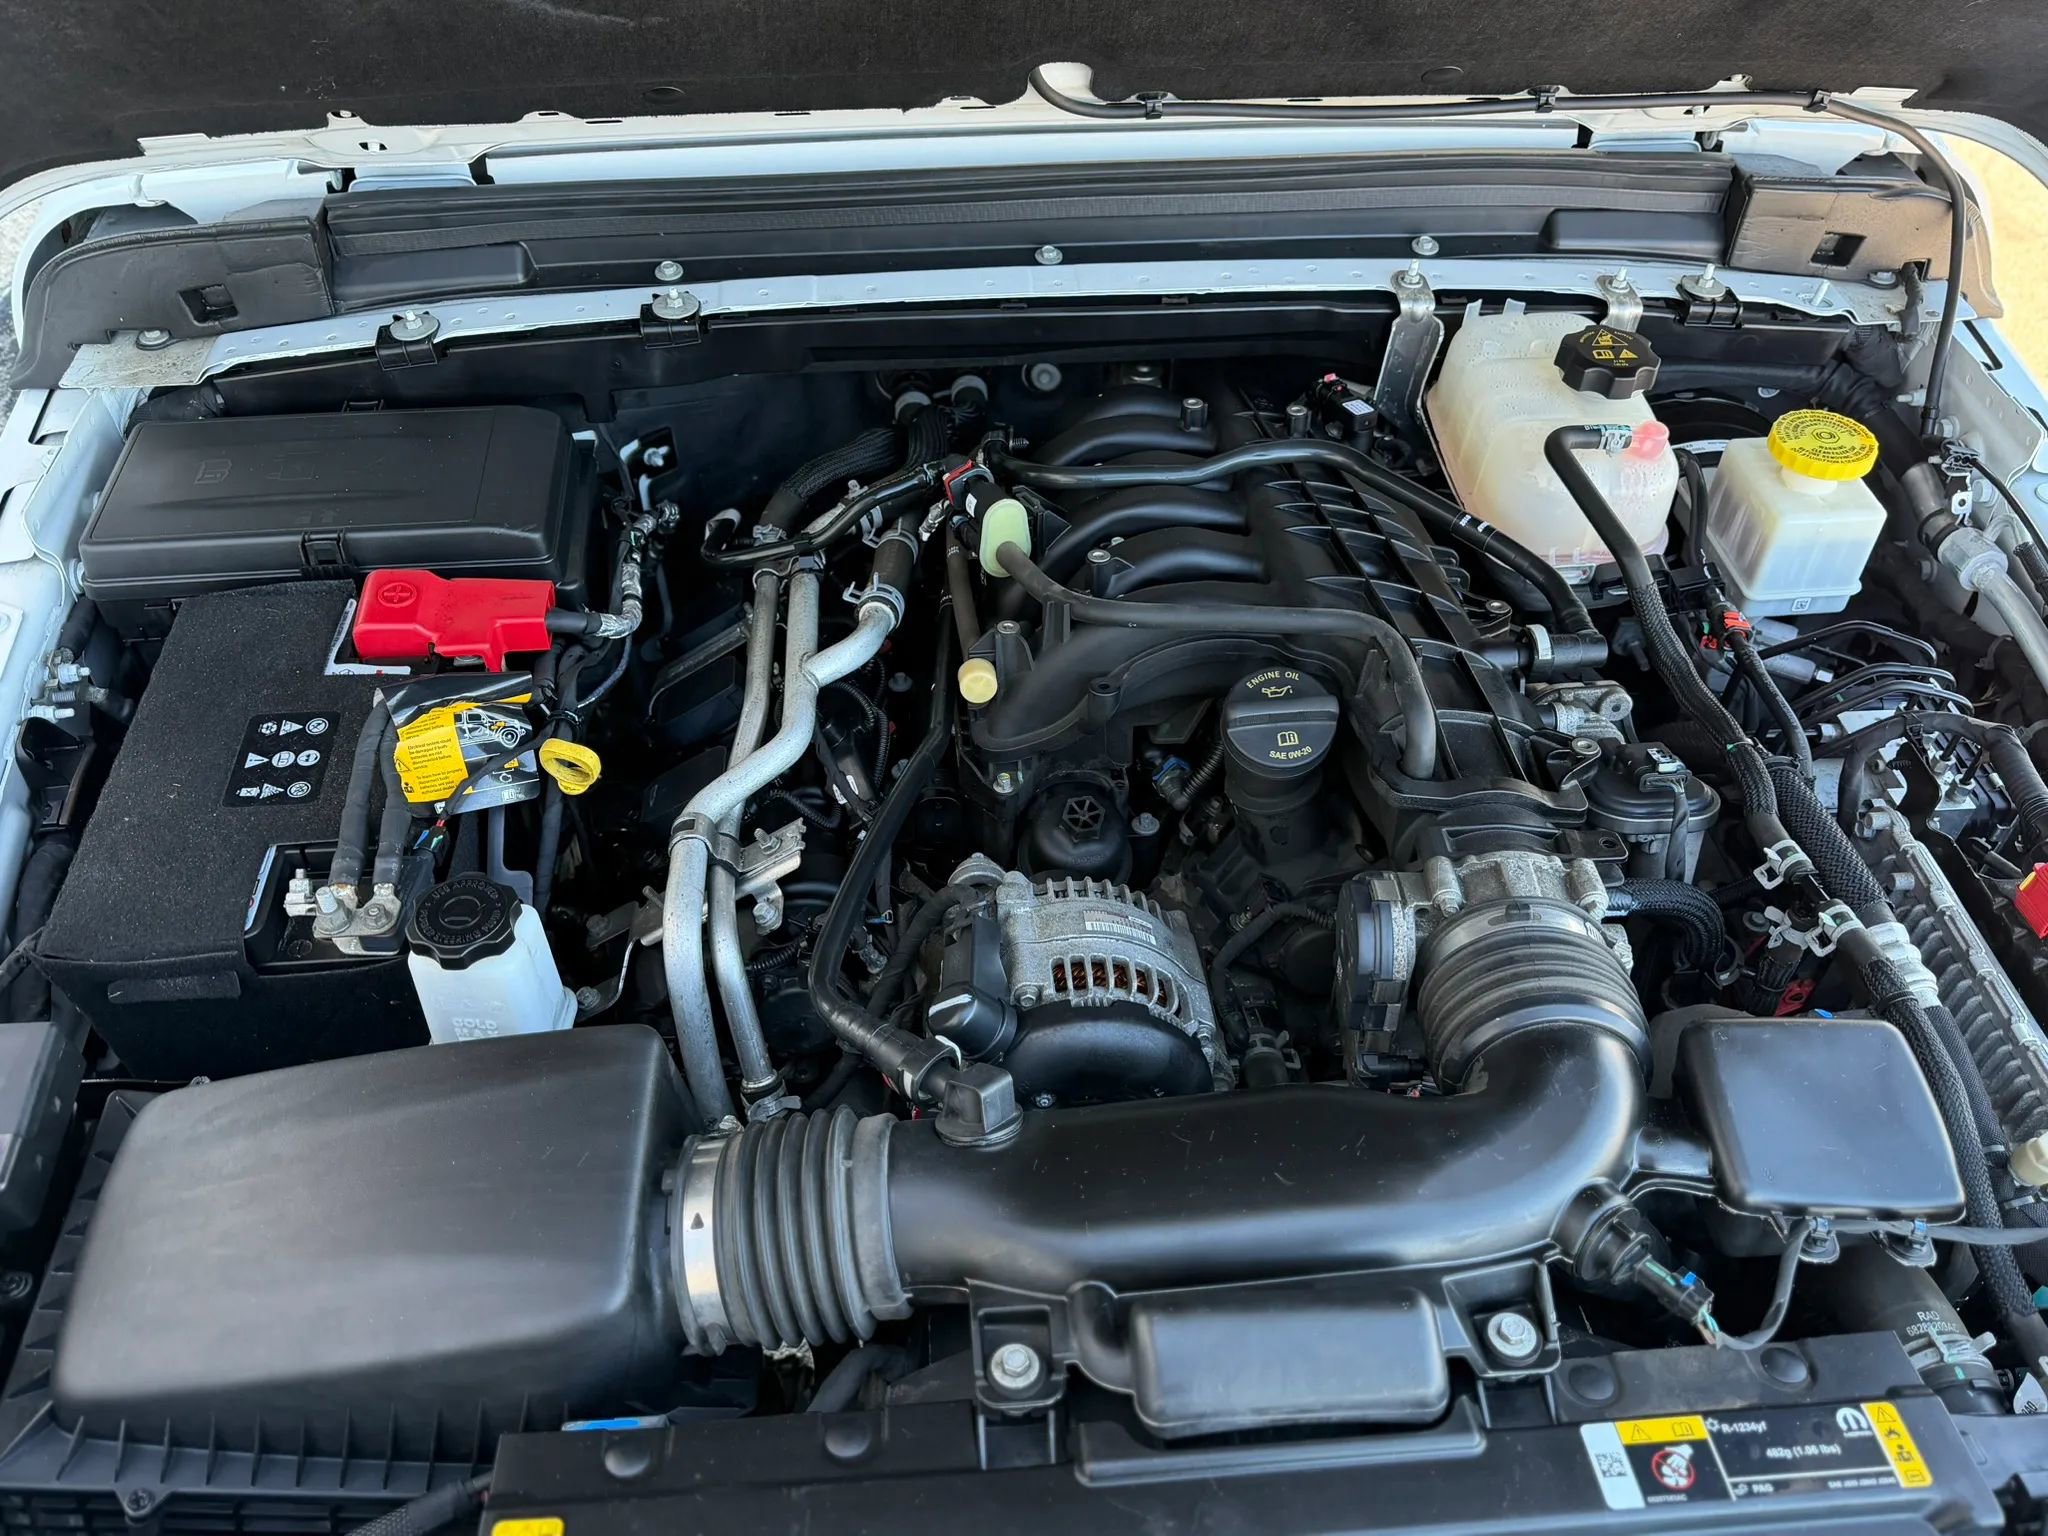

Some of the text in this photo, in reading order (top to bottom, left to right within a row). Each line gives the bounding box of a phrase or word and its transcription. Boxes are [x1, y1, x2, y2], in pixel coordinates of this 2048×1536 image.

[1246, 670, 1300, 689] ENGINE OIL
[1269, 746, 1312, 760] SAE 0W-20
[452, 880, 499, 900] APPROVED
[452, 1017, 497, 1030] COLD
[1916, 1310, 1940, 1321] RAD
[1720, 1420, 1767, 1434] R-1234yf
[1820, 1443, 1842, 1456] lbs)
[1752, 1483, 1774, 1493] PAG
